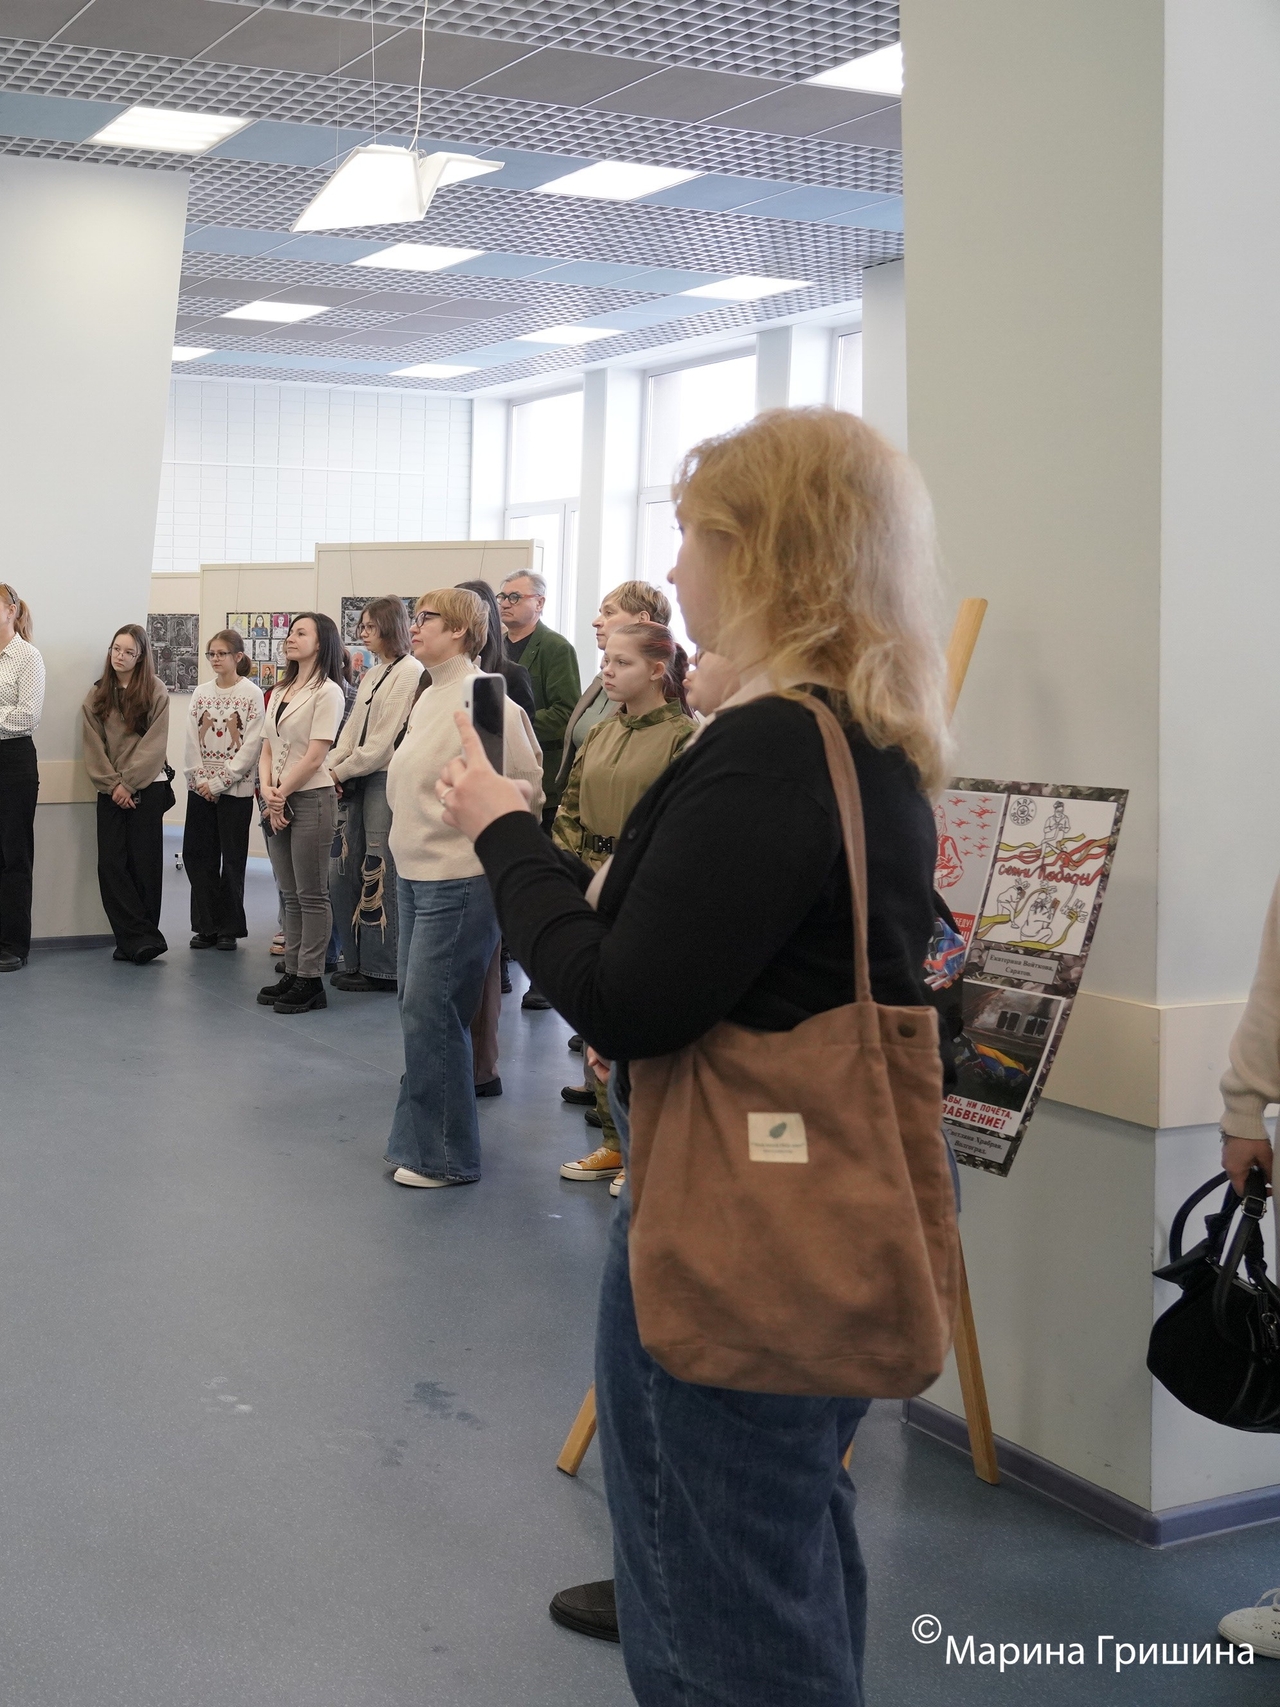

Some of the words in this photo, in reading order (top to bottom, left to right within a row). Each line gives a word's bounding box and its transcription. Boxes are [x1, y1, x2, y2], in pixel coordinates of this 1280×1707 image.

[990, 955, 1022, 966] Екатерина
[943, 1095, 962, 1106] АВЫ,
[966, 1100, 978, 1109] НИ
[980, 1104, 1012, 1120] ПОЧЁТА,
